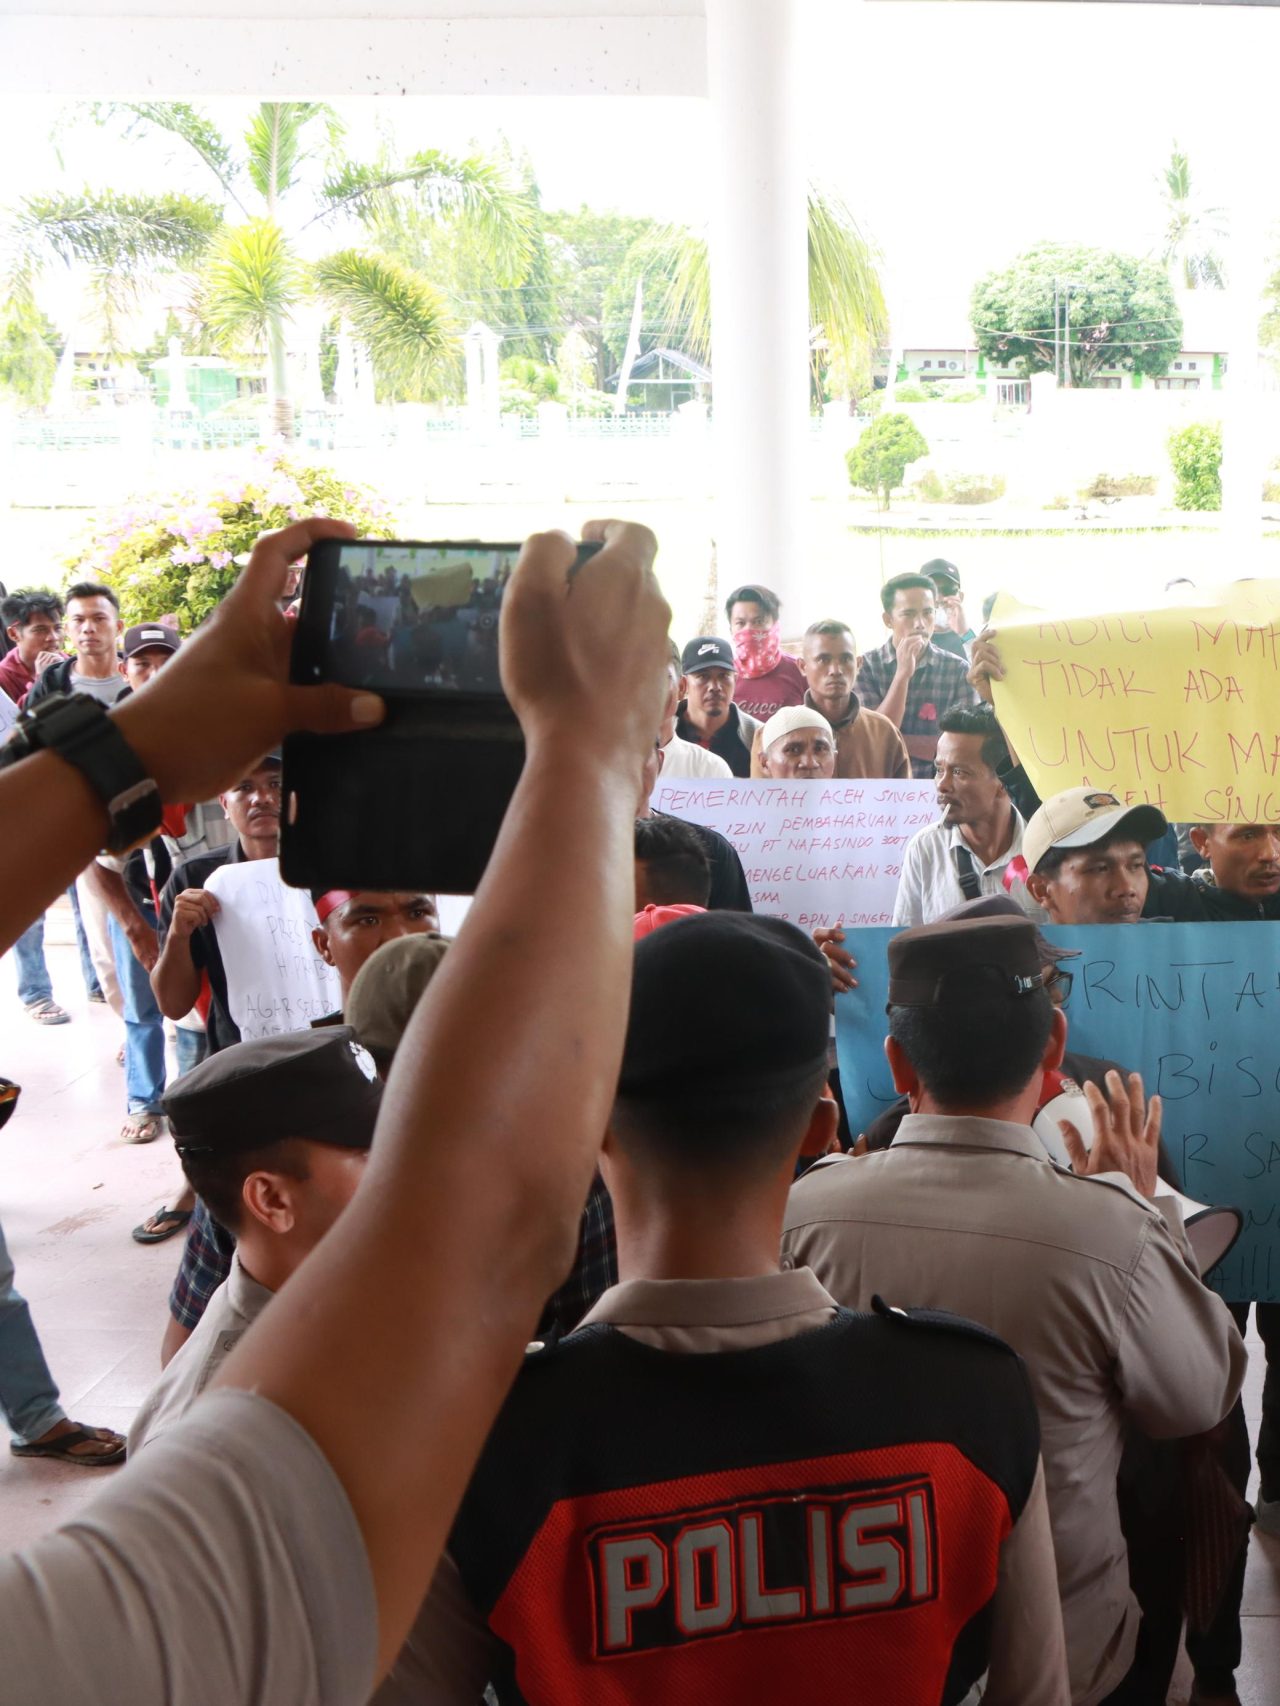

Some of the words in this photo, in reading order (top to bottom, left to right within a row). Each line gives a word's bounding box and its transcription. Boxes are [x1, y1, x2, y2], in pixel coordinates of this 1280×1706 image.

[1022, 659, 1156, 700] TIDAK
[1183, 669, 1243, 704] ADA
[1028, 726, 1207, 781] UNTUK
[659, 788, 807, 811] PEMERINTAH
[820, 788, 865, 806] ACEH
[873, 789, 936, 804] SINGKI
[725, 821, 767, 836] IZIN
[903, 811, 934, 825] IZIN
[761, 839, 781, 854] PT
[786, 834, 874, 856] NAFASINDO
[750, 891, 781, 904] SMA
[798, 912, 829, 929] BPN
[601, 1490, 932, 1648] POLISI
